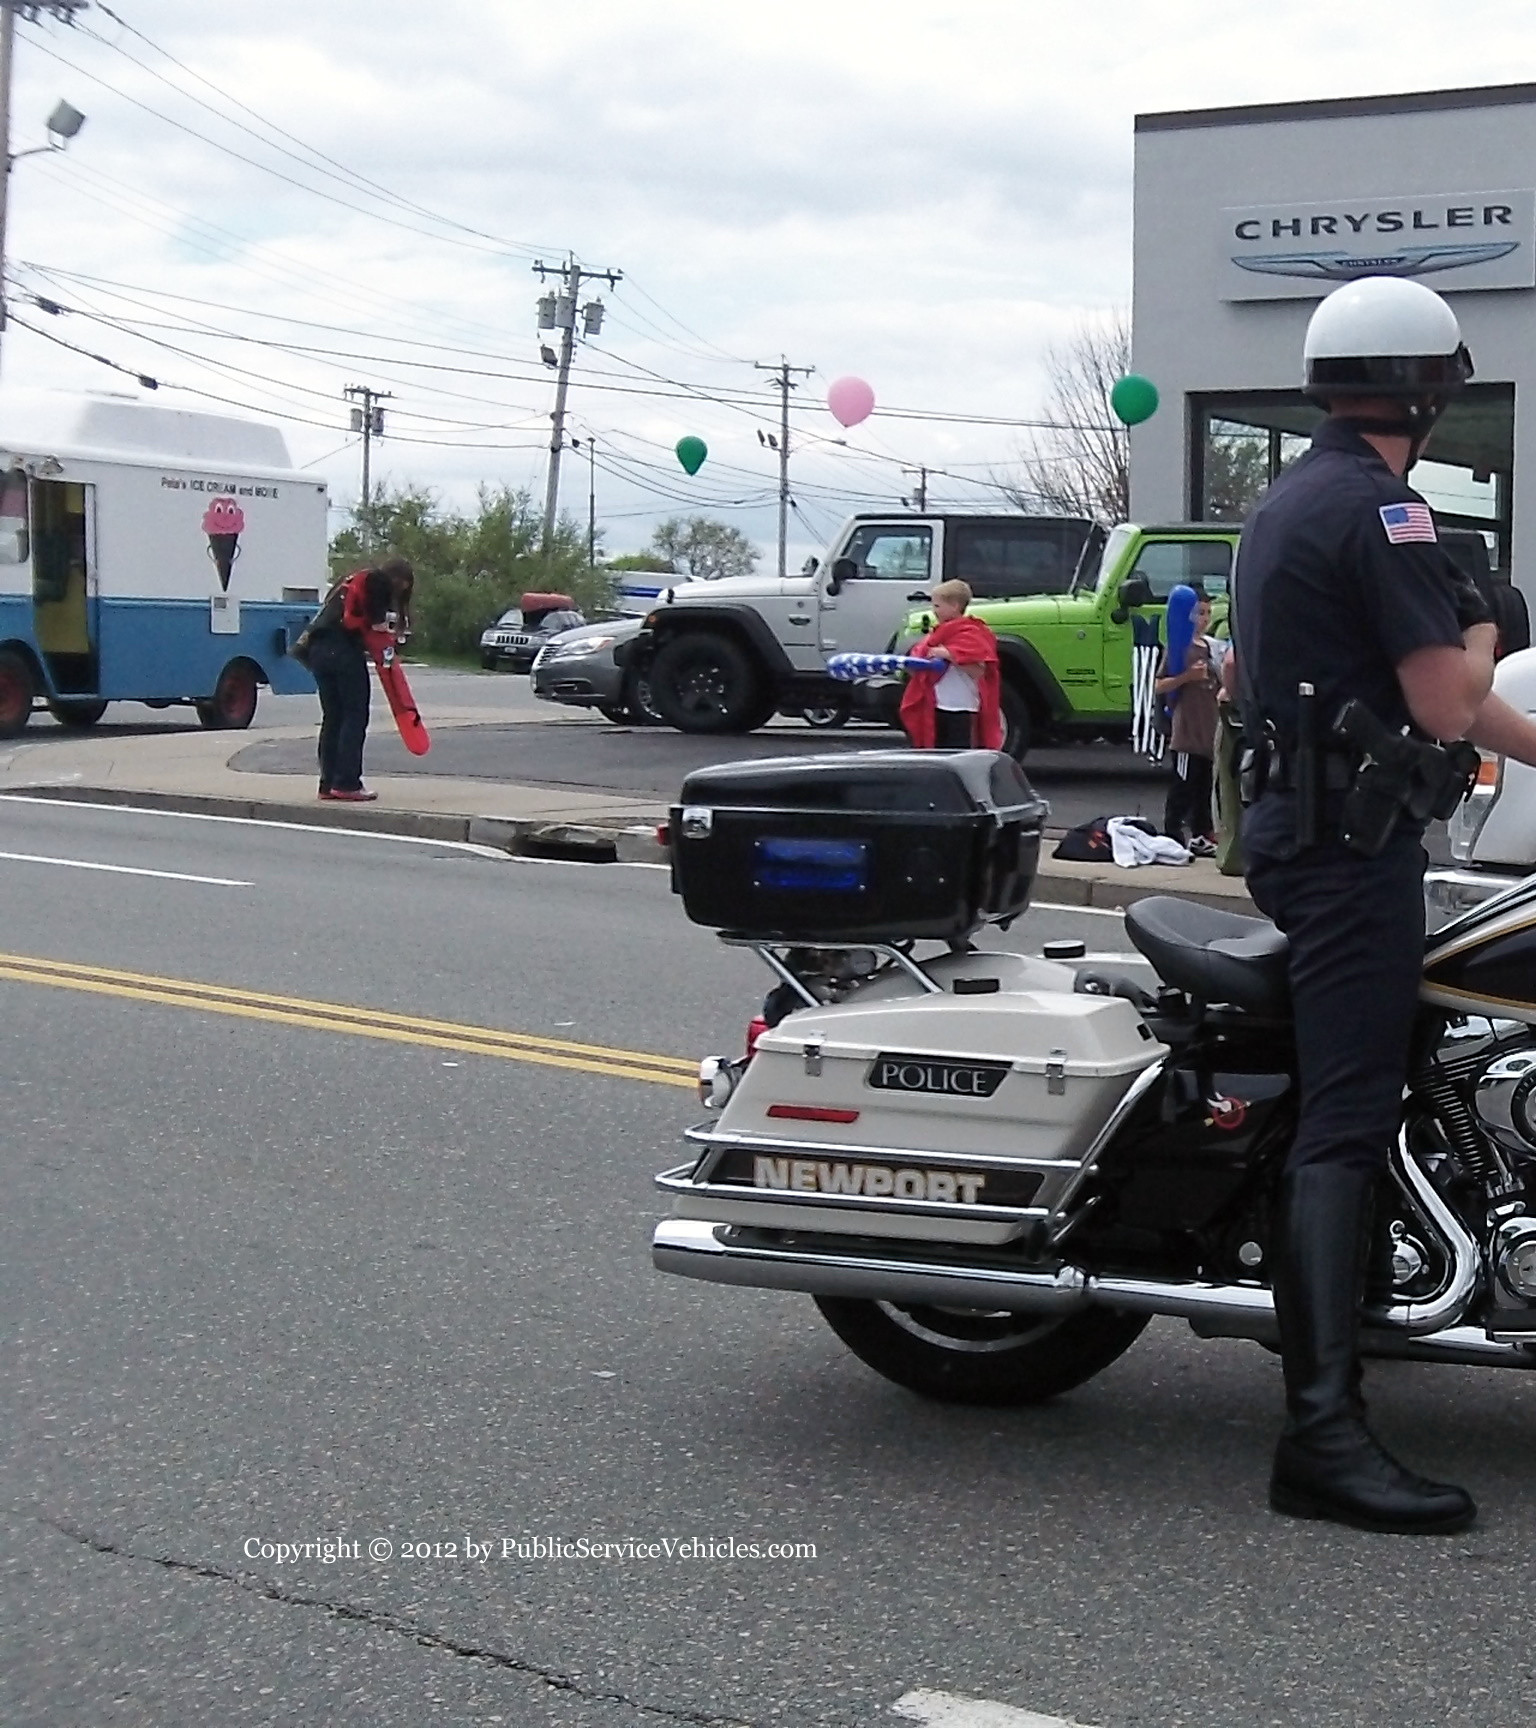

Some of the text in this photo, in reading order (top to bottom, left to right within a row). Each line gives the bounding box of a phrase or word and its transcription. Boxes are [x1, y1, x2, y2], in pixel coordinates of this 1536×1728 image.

[1235, 205, 1512, 240] CHRYSLER
[190, 480, 204, 491] ICE
[255, 487, 278, 498] MOE
[882, 1063, 988, 1094] POLICE
[754, 1156, 986, 1204] NEWPORT
